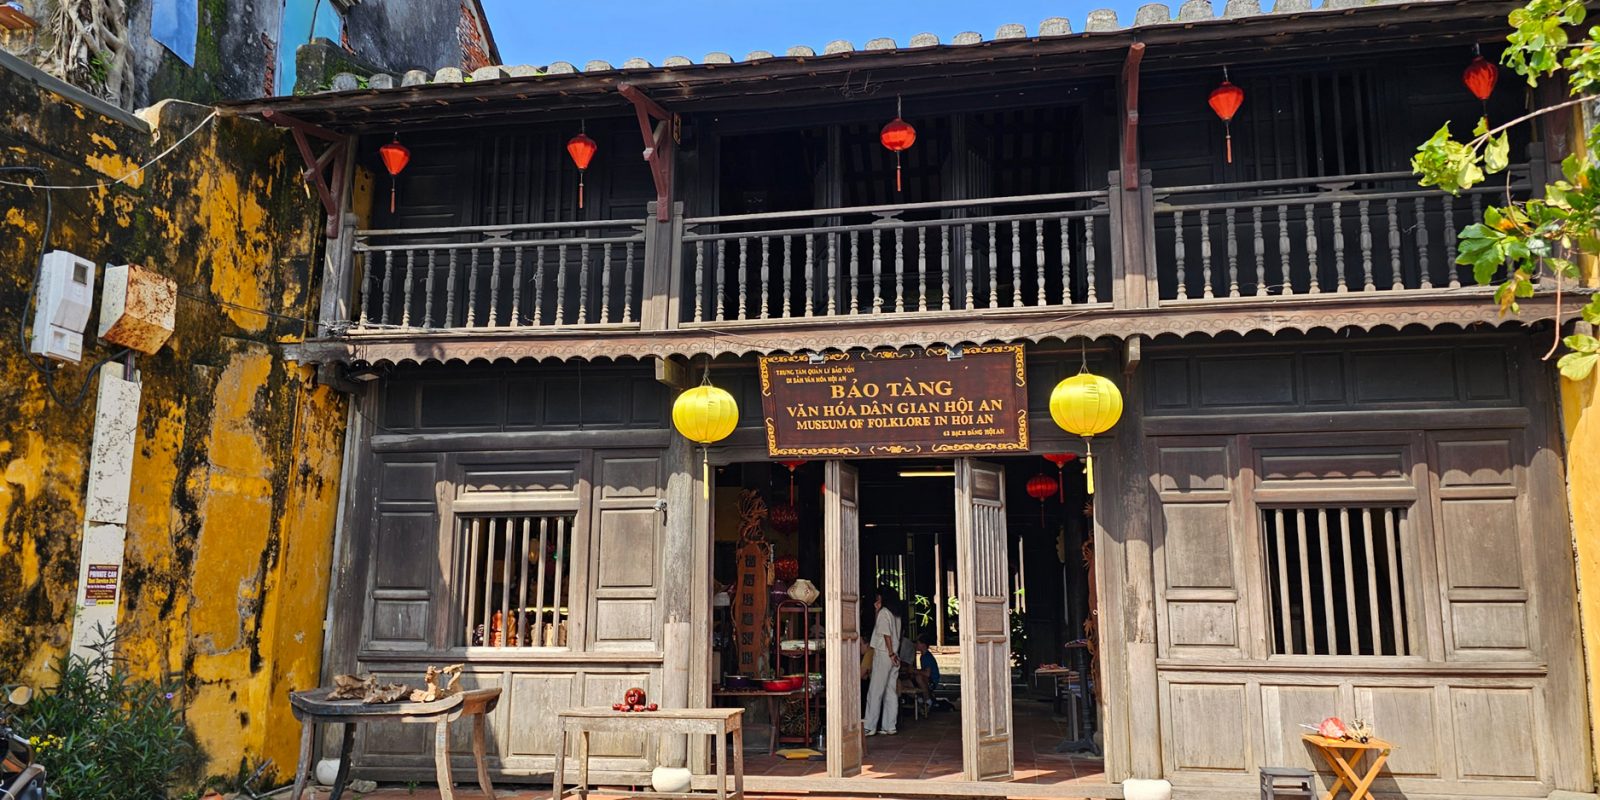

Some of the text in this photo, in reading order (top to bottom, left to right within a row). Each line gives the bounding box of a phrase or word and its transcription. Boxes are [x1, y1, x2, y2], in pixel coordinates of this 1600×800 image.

[830, 377, 953, 399] BẢO TÀNG
[786, 397, 1003, 417] VĂN HÓA DÂN GIAN HỘI AN
[797, 414, 994, 430] MUSEUM OF FOLKLORE IN HOI AN
